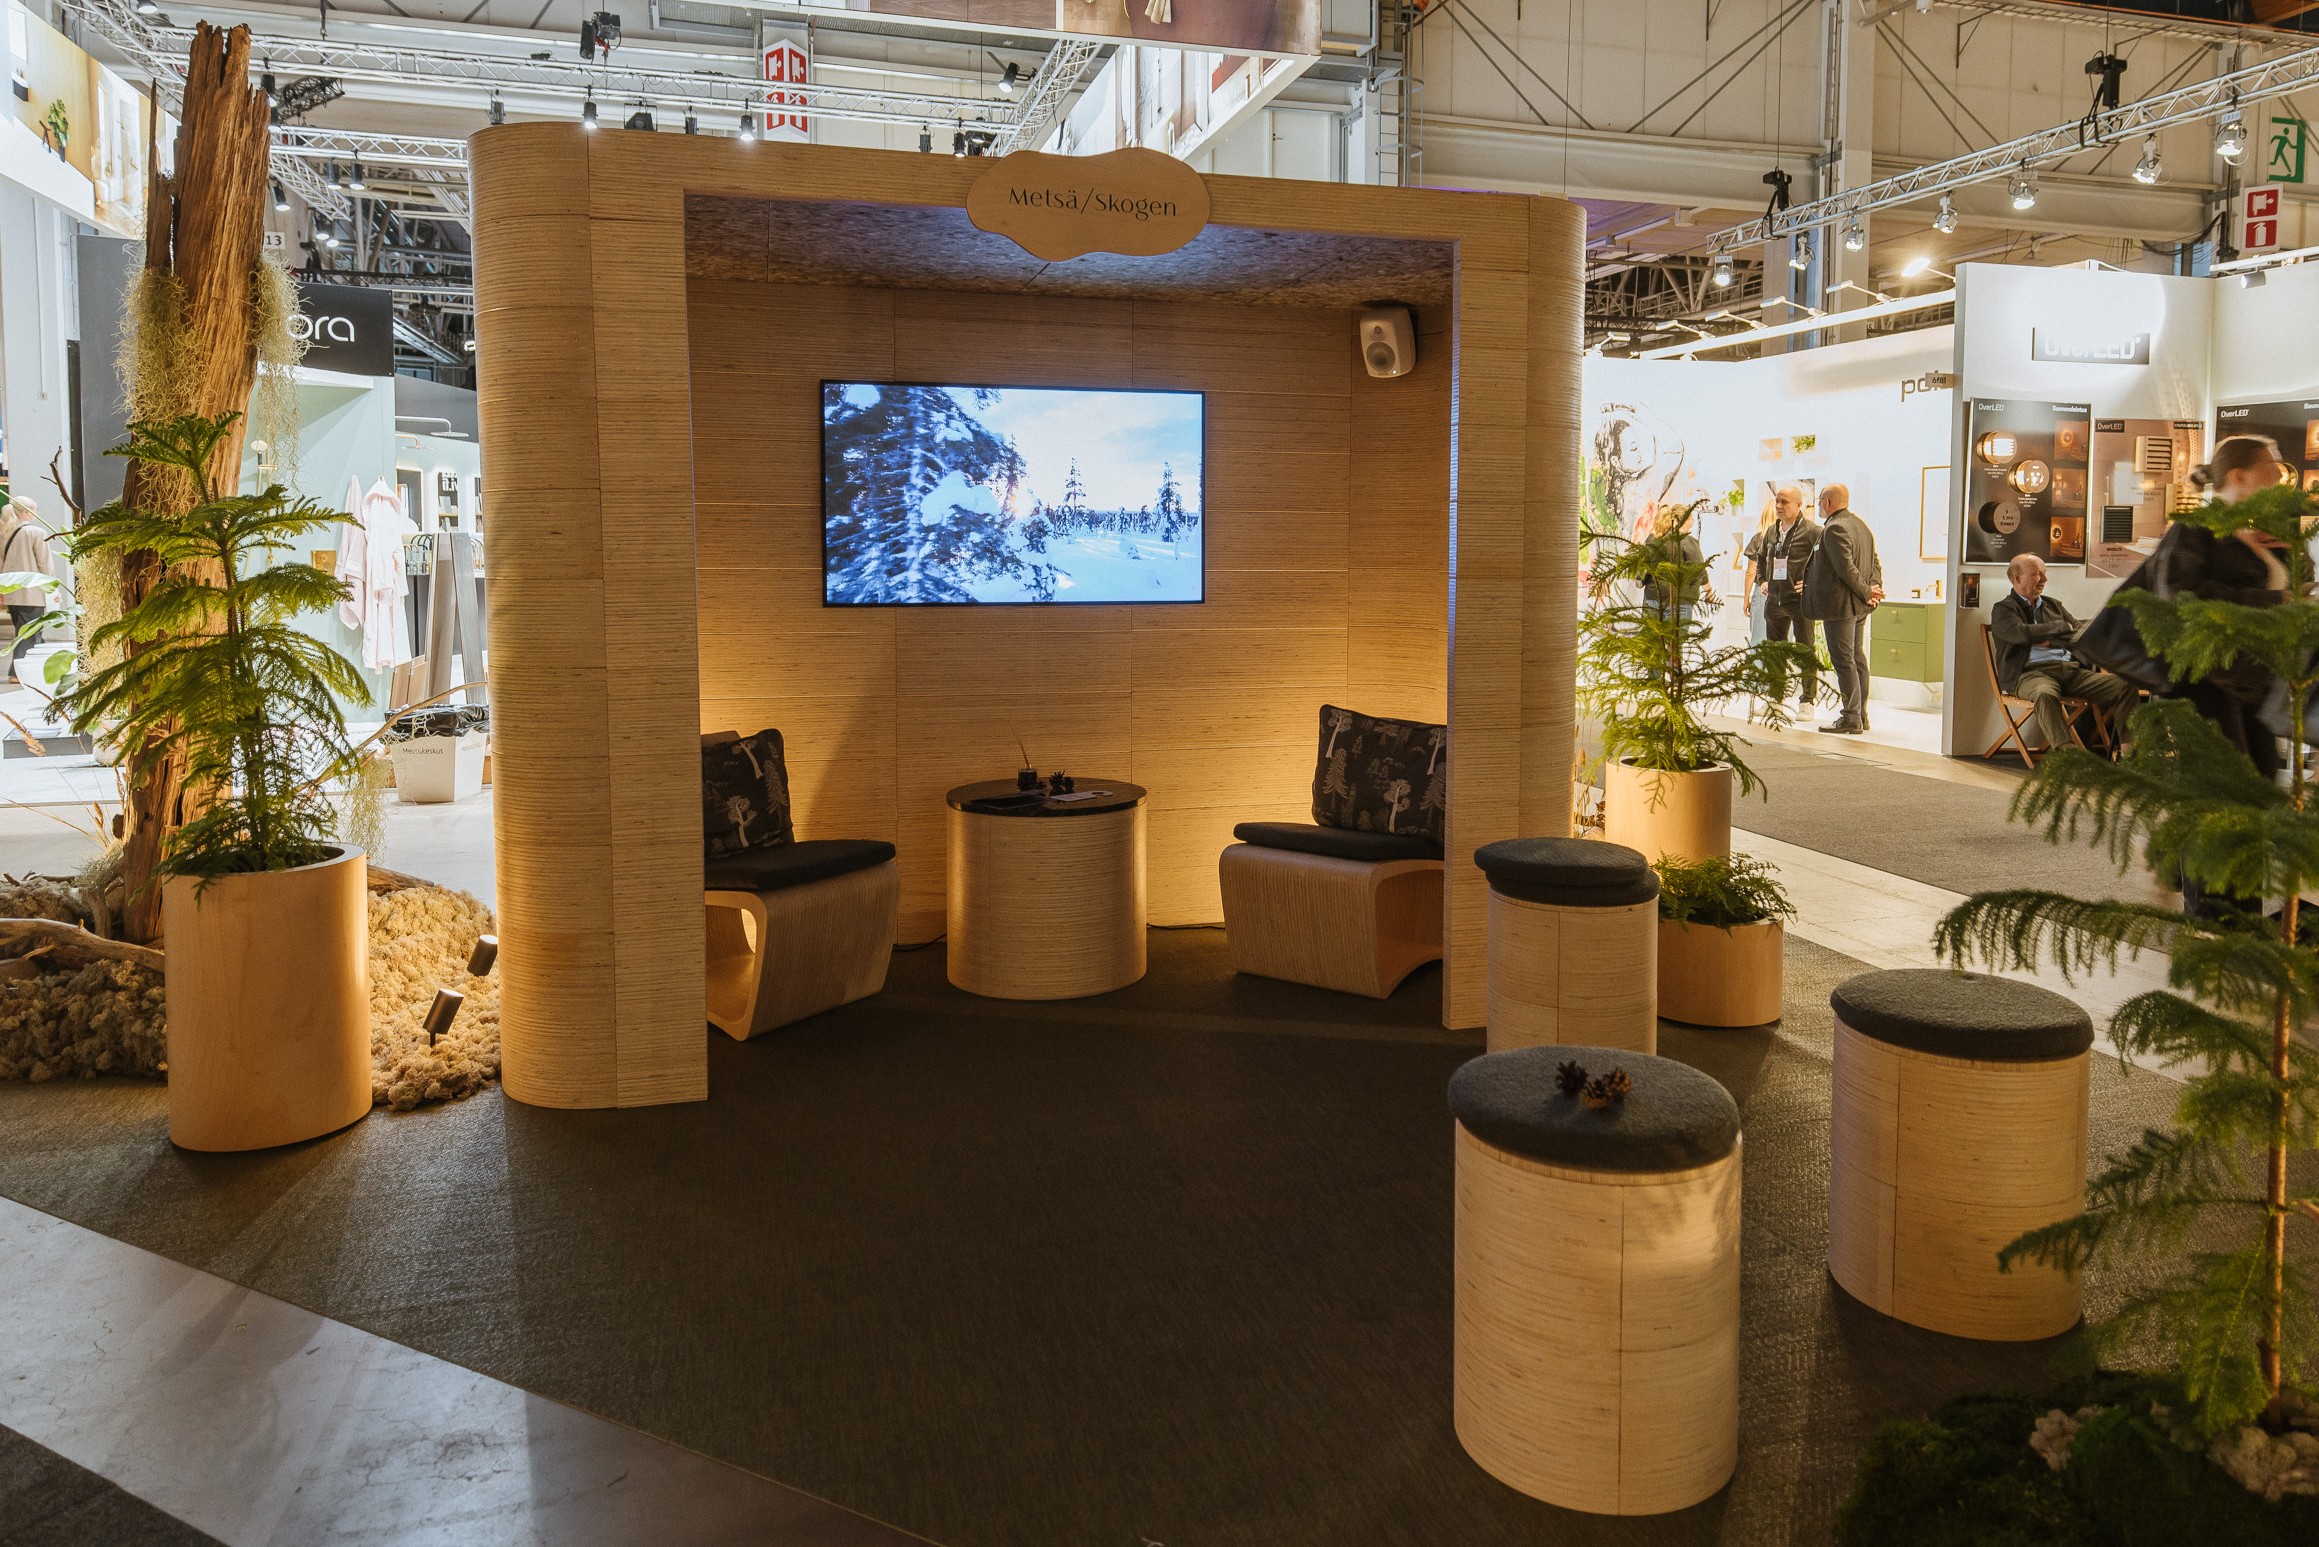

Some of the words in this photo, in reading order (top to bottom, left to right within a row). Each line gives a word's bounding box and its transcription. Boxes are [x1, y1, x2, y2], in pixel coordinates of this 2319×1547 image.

[1009, 187, 1176, 221] Metsä/Skogen
[1978, 403, 2005, 412] OverLED
[2221, 409, 2250, 418] OverLED
[2097, 422, 2123, 430] OverLED
